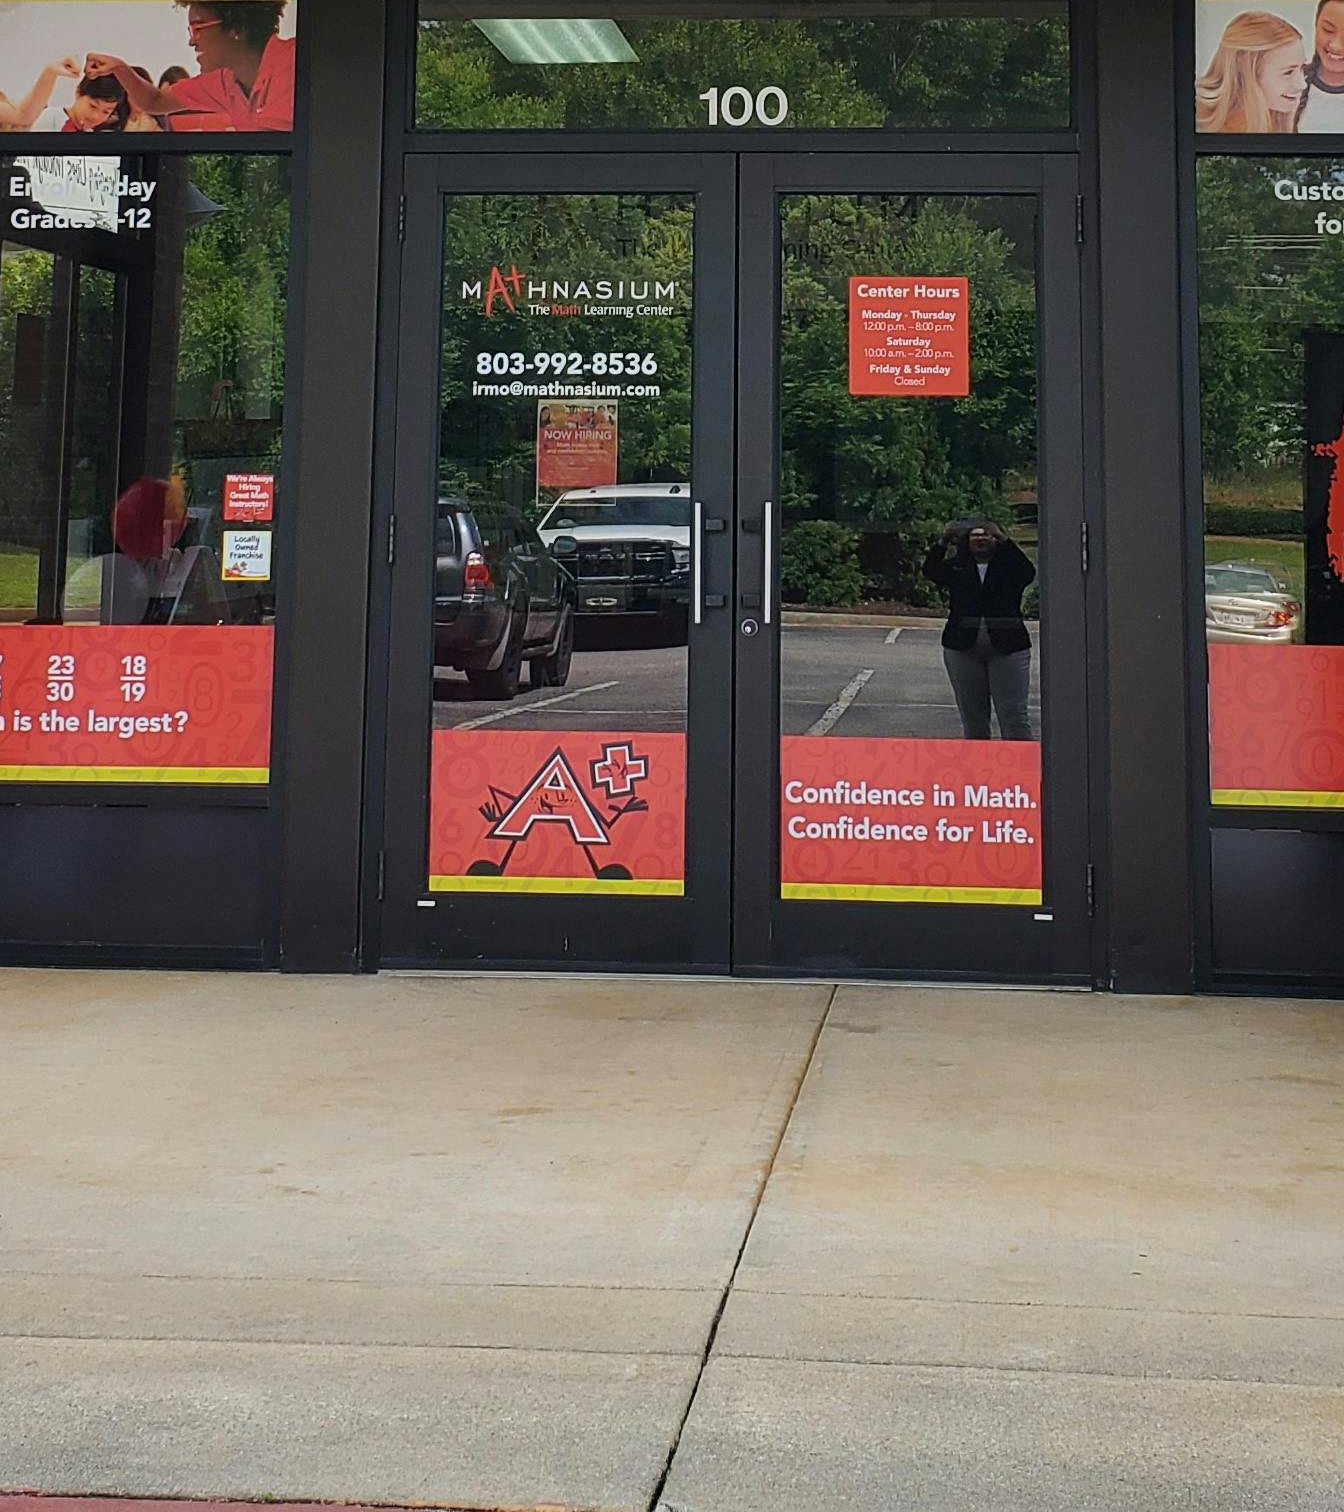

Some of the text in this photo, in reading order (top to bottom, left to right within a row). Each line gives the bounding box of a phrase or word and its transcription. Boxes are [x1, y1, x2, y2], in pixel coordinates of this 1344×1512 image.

[699, 86, 789, 127] 100
[98, 208, 151, 228] -12
[857, 284, 960, 299] Center Hours
[528, 303, 674, 318] The Math Learning Center
[862, 309, 903, 321] Monday
[910, 309, 956, 321] Thursday
[886, 337, 931, 348] Saturday
[476, 352, 658, 375] 803-992-8536
[869, 364, 951, 376] Friday & Sunday
[472, 380, 660, 397] irmo@mathnasium.com
[894, 376, 926, 386] Closed
[543, 429, 612, 441] NOW HIRING
[13, 709, 32, 732] is
[39, 709, 80, 733] the
[87, 709, 189, 738] largest?
[784, 780, 1038, 810] Confidence in Math.
[787, 816, 1035, 845] Confidence for Life.
